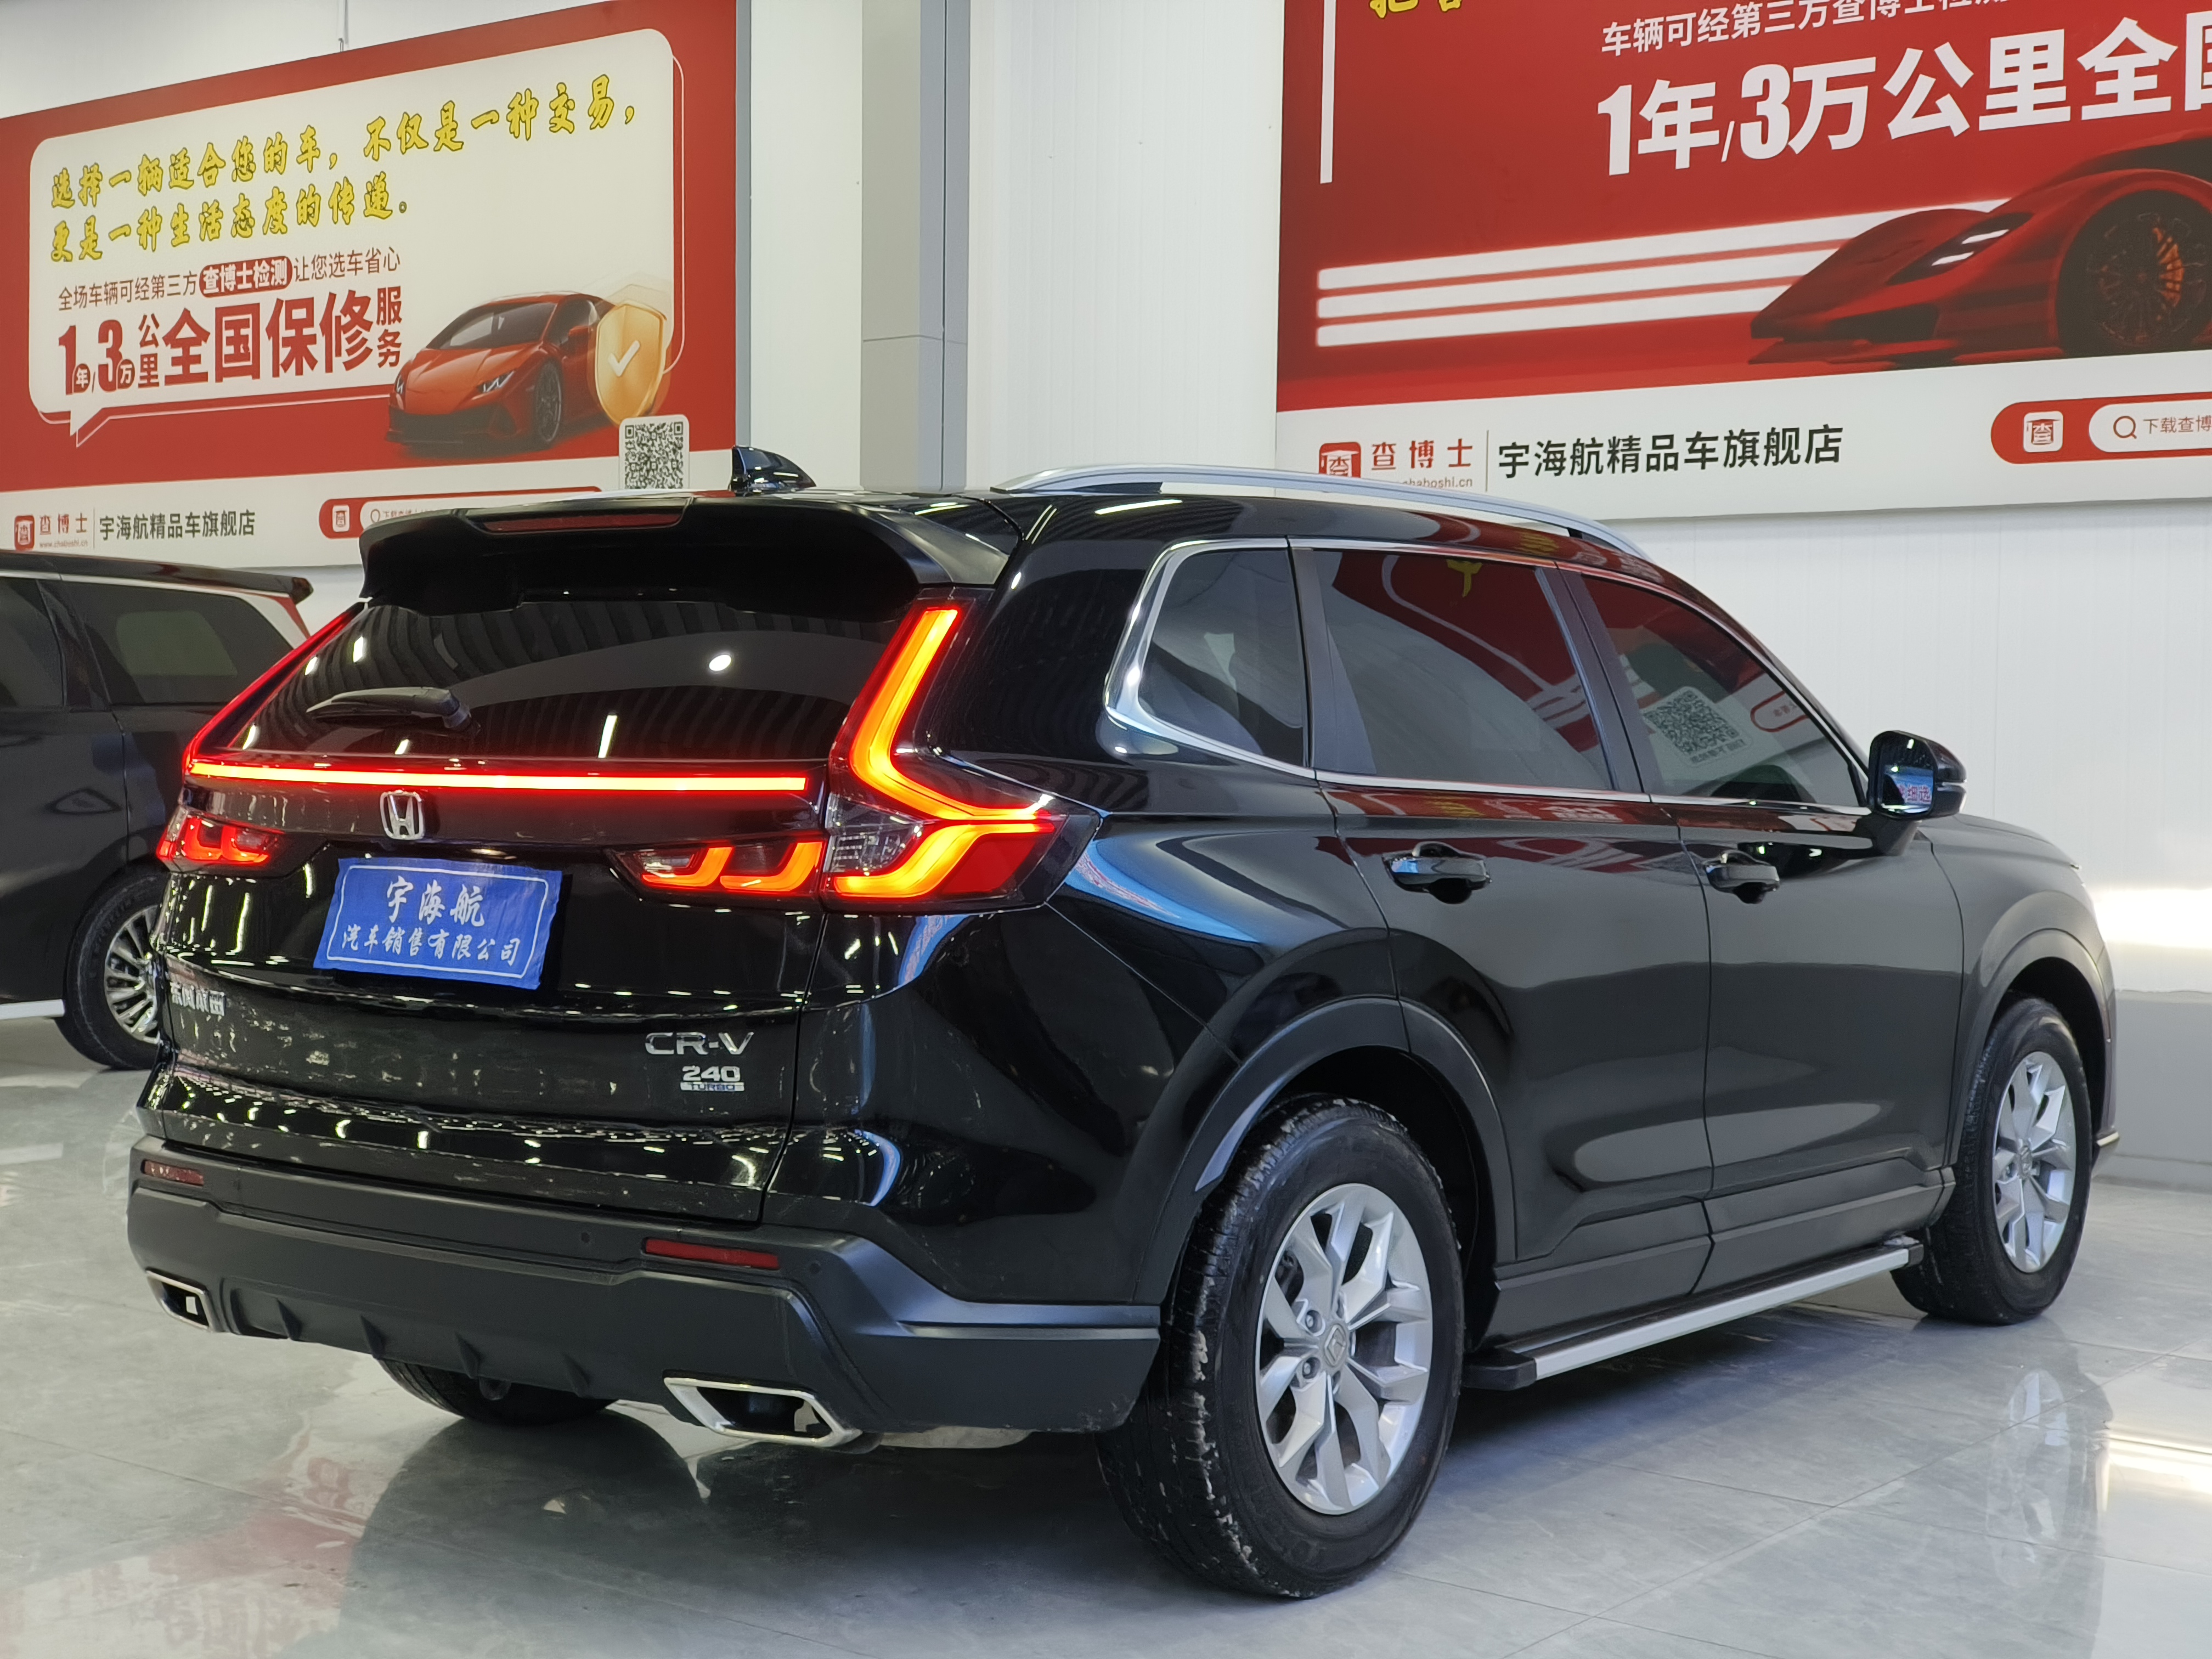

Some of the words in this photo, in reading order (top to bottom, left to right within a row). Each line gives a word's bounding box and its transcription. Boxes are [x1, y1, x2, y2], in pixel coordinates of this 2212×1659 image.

[1601, 0, 2009, 55] 车辆可经第三方查博
[50, 171, 407, 262] 更是一种生活态度的传递。
[1372, 438, 1473, 470] 查博士
[1498, 424, 1843, 479] 宇海航精品车旗舰店
[99, 509, 256, 540] 宇海航精品车旗舰店
[387, 876, 485, 927] 宇海航
[341, 923, 521, 967] 汽车销售有限公司
[645, 1031, 754, 1055] CR-V
[682, 1065, 741, 1082] 240
